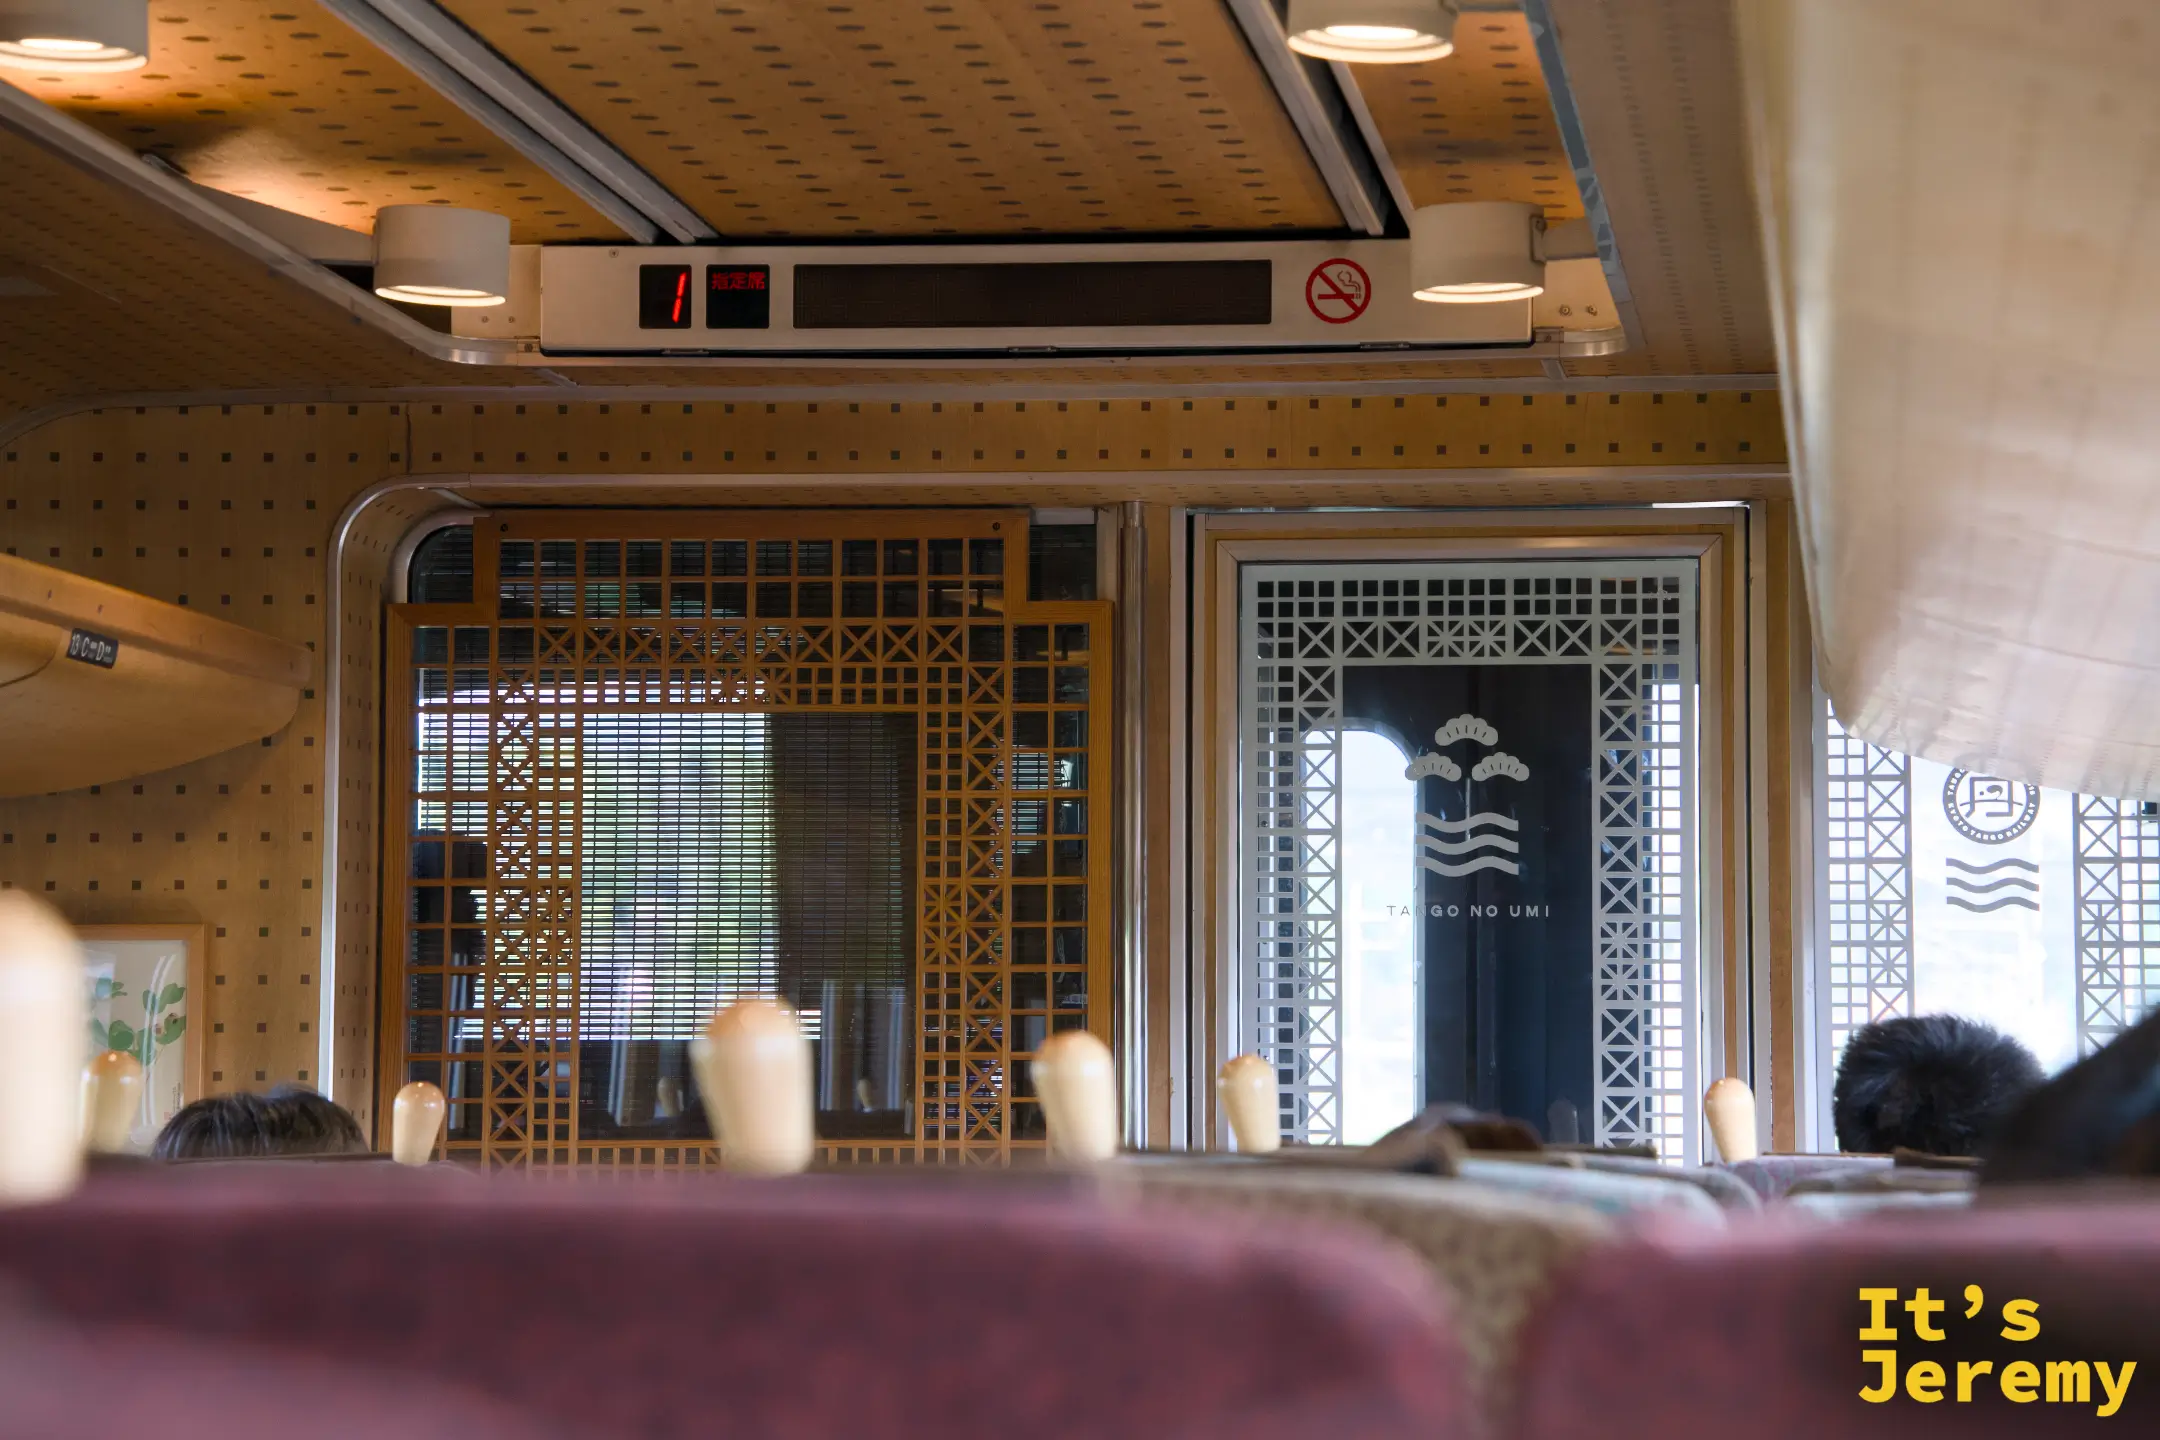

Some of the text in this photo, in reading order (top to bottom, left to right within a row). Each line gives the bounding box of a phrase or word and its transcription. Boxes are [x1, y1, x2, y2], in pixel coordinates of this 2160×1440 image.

[711, 271, 766, 290] 指定席
[672, 272, 687, 323] 1
[81, 636, 90, 657] C
[96, 641, 105, 661] D
[1947, 802, 2036, 841] KYOTO TANGO RAILWAY
[1386, 904, 1549, 918] TANGO NO UMI
